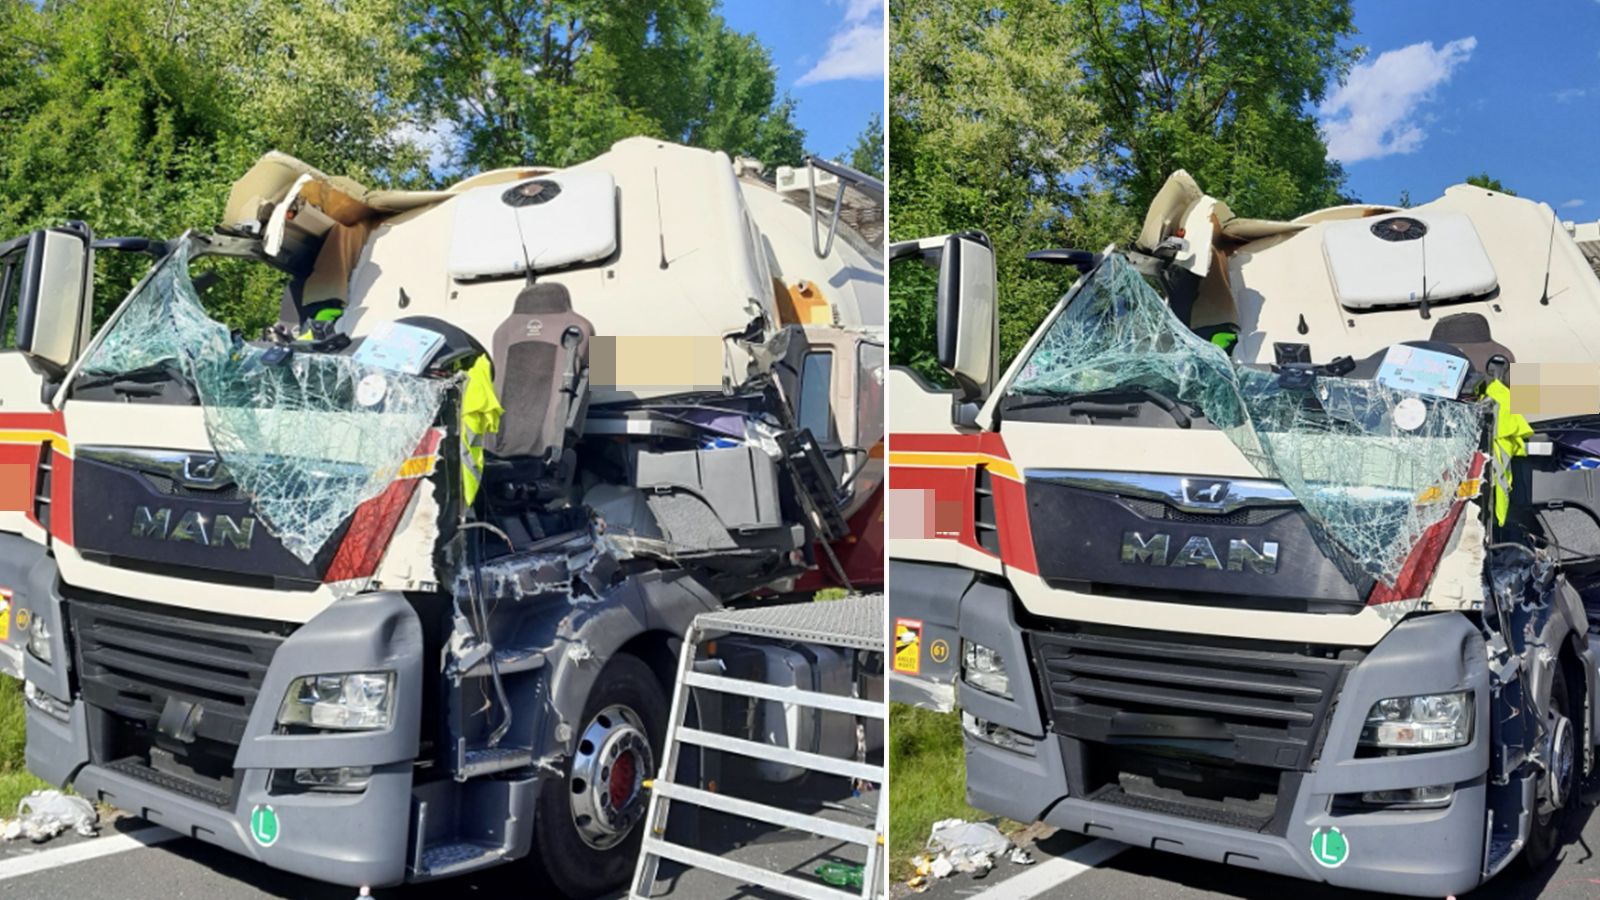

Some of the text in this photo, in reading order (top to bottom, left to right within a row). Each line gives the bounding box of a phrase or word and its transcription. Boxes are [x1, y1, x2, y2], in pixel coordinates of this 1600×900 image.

[131, 505, 256, 550] MAN
[1120, 531, 1279, 575] MAN
[933, 645, 945, 657] 61
[258, 810, 271, 840] L
[1321, 833, 1338, 861] L
